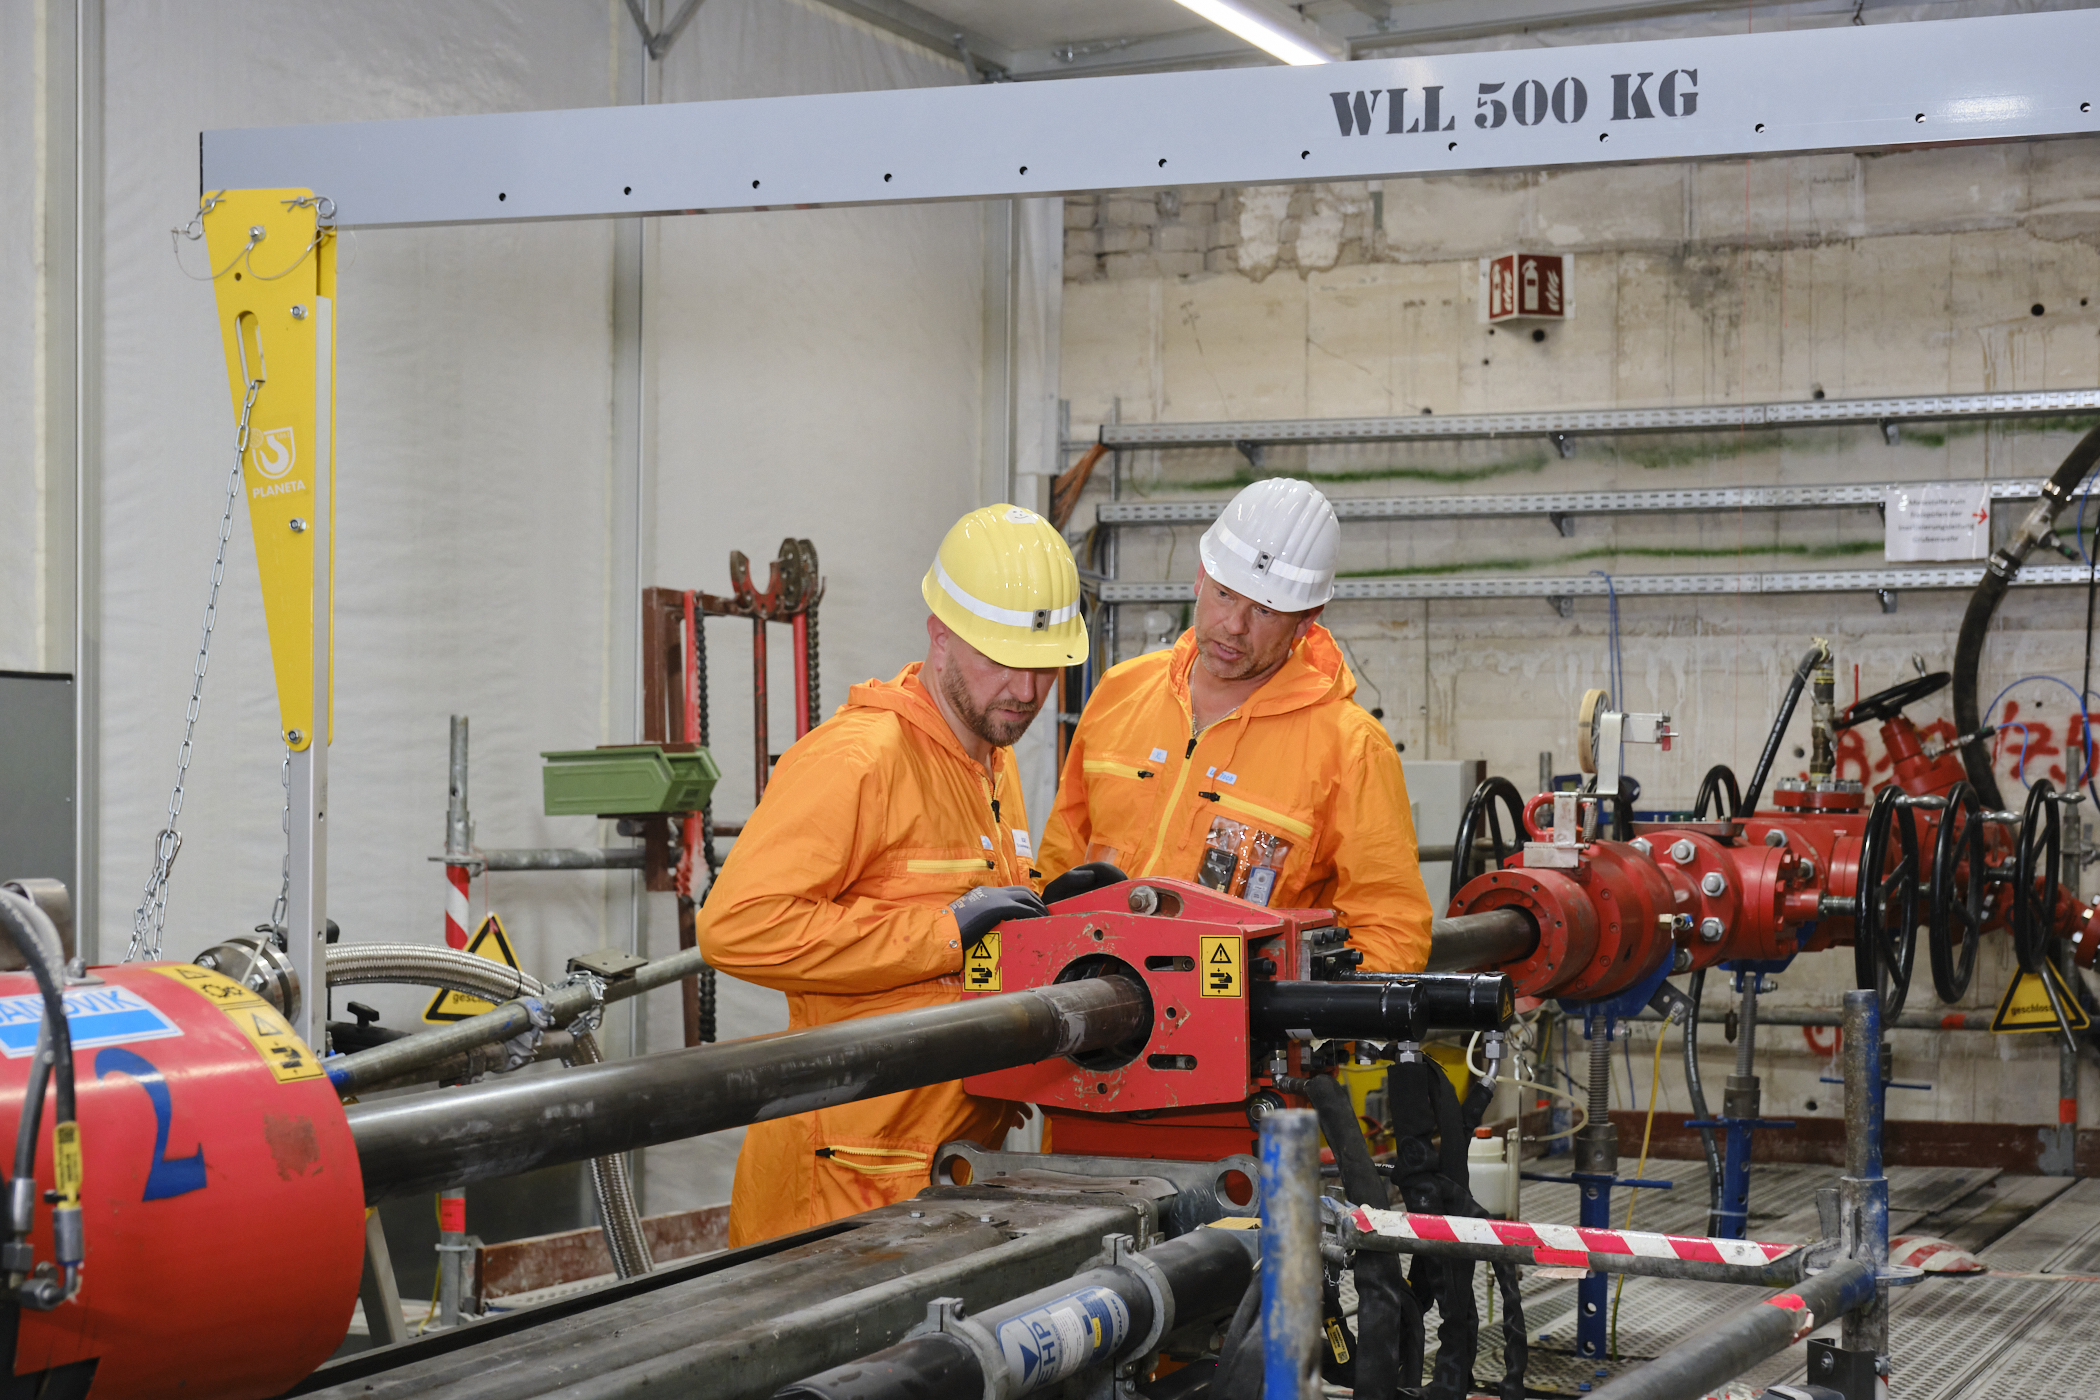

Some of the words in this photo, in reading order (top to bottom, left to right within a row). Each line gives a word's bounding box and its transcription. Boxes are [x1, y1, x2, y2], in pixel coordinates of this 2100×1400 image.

[1330, 86, 1455, 137] WLL
[1474, 77, 1588, 129] 500
[1610, 69, 1699, 120] KG
[252, 479, 306, 499] PLANETA
[0, 990, 141, 1022] ANDVIK
[94, 1047, 207, 1202] 2
[1031, 1320, 1056, 1387] EHP
